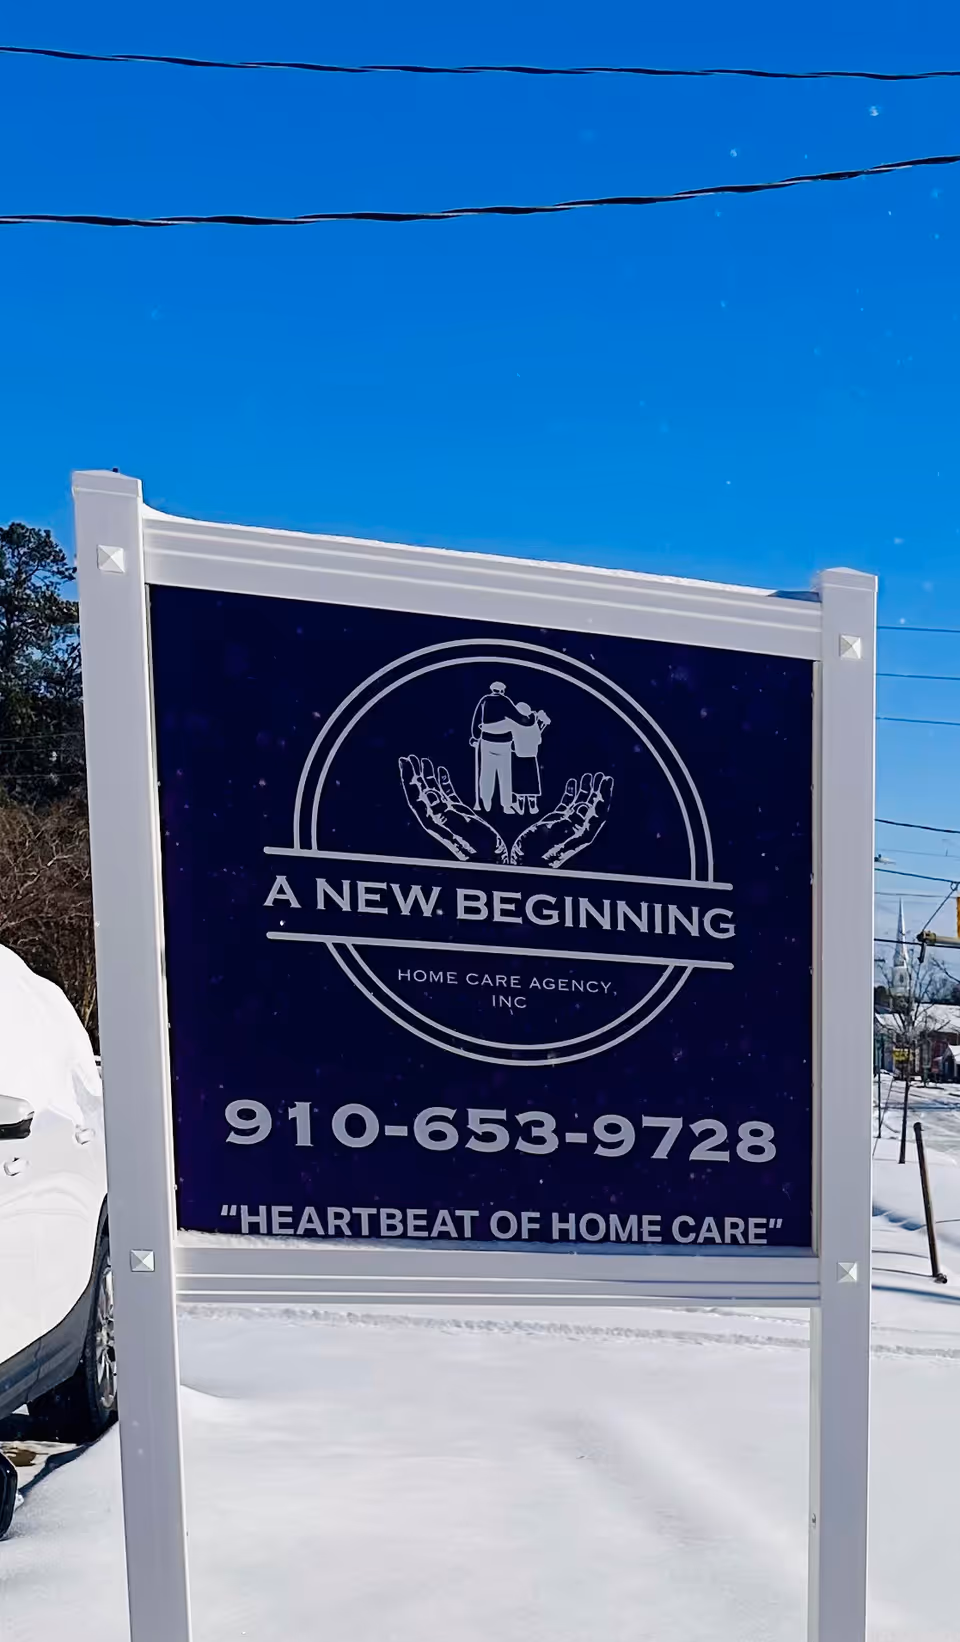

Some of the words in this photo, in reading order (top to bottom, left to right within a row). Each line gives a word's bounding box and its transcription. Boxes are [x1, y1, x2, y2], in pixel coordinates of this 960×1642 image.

[263, 875, 302, 909] A
[314, 878, 442, 917] NEW
[456, 888, 737, 939] BEGINNING
[397, 969, 459, 985] HOME
[465, 973, 522, 988] CARE
[492, 995, 527, 1009] INC
[225, 1099, 777, 1163] 910-653-9728
[490, 1210, 540, 1239] OF
[551, 1212, 662, 1243] HOME
